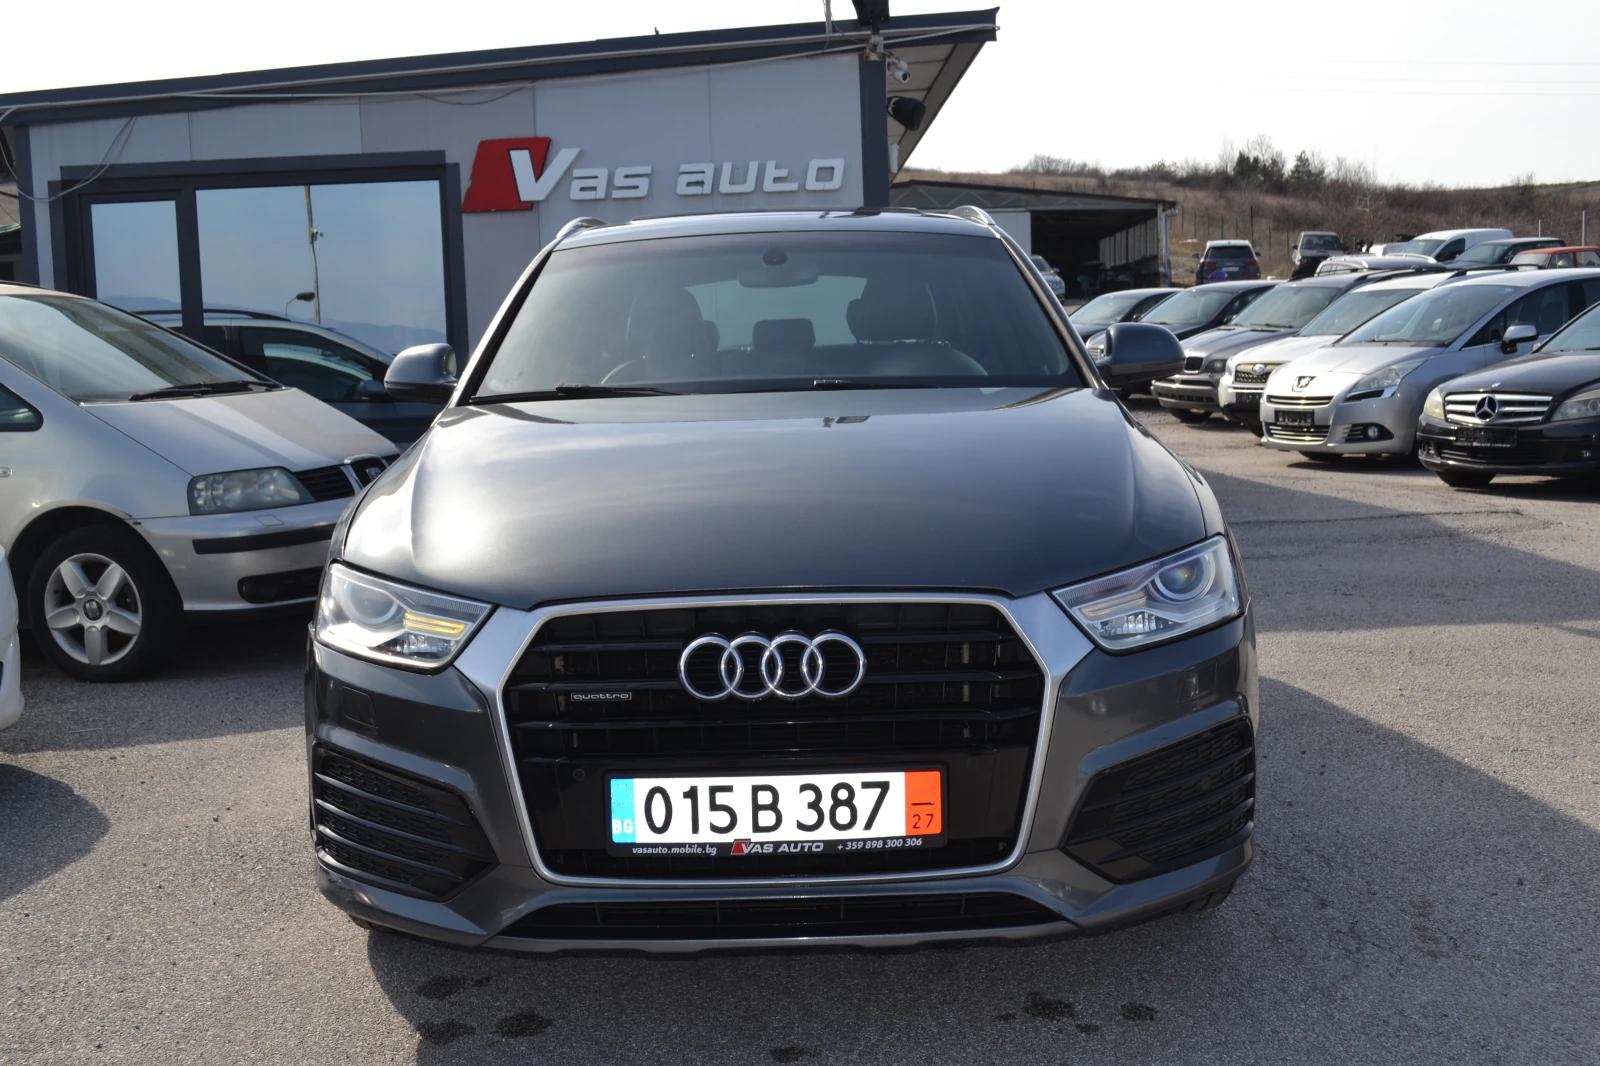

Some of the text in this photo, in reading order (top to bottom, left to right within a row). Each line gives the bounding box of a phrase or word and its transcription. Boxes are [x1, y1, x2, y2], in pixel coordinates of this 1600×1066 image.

[508, 147, 846, 202] Vas auto
[573, 693, 629, 701] quattro
[644, 780, 891, 835] 015 B 387
[612, 818, 634, 835] BG
[912, 812, 935, 829] 27
[632, 843, 718, 856] vasauto.mobile.bg
[741, 842, 825, 854] VAS AUTO
[845, 841, 864, 850] 359
[865, 839, 884, 849] 898
[886, 838, 905, 848] 300
[905, 837, 923, 847] 306
